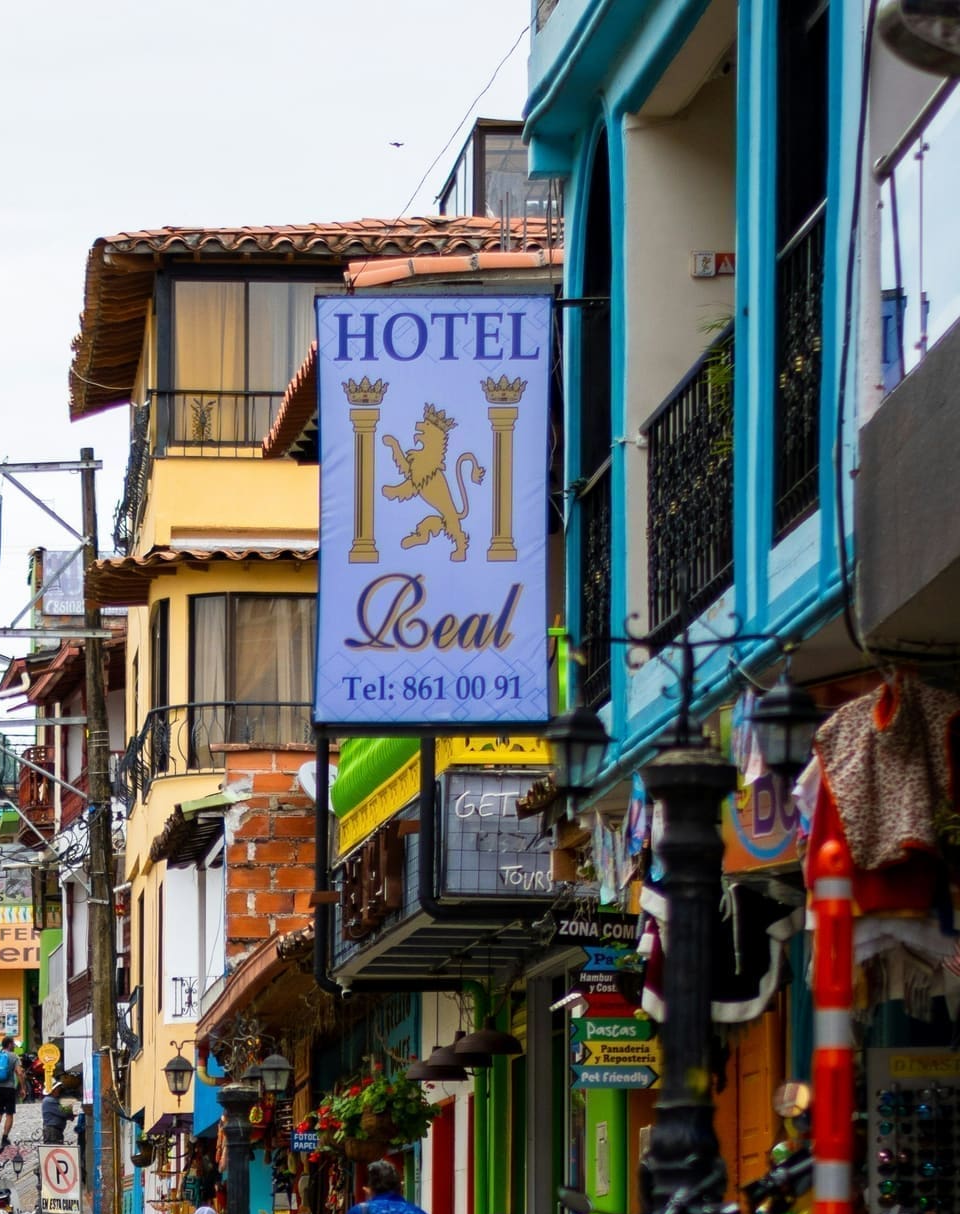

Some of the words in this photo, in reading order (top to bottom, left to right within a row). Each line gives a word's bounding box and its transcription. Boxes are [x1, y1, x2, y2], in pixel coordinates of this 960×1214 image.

[333, 311, 540, 362] HOTEL
[343, 572, 524, 653] Real
[342, 675, 394, 702] Tel:
[402, 675, 444, 702] 861
[455, 675, 485, 702] 00
[494, 675, 522, 701] 91
[0, 928, 40, 941] FER
[558, 919, 599, 937] ZONA
[579, 972, 614, 983] Hambur
[586, 1021, 637, 1039] Pastas
[594, 1056, 601, 1064] y
[580, 1071, 600, 1083] Pet
[603, 1070, 649, 1085] Friendly
